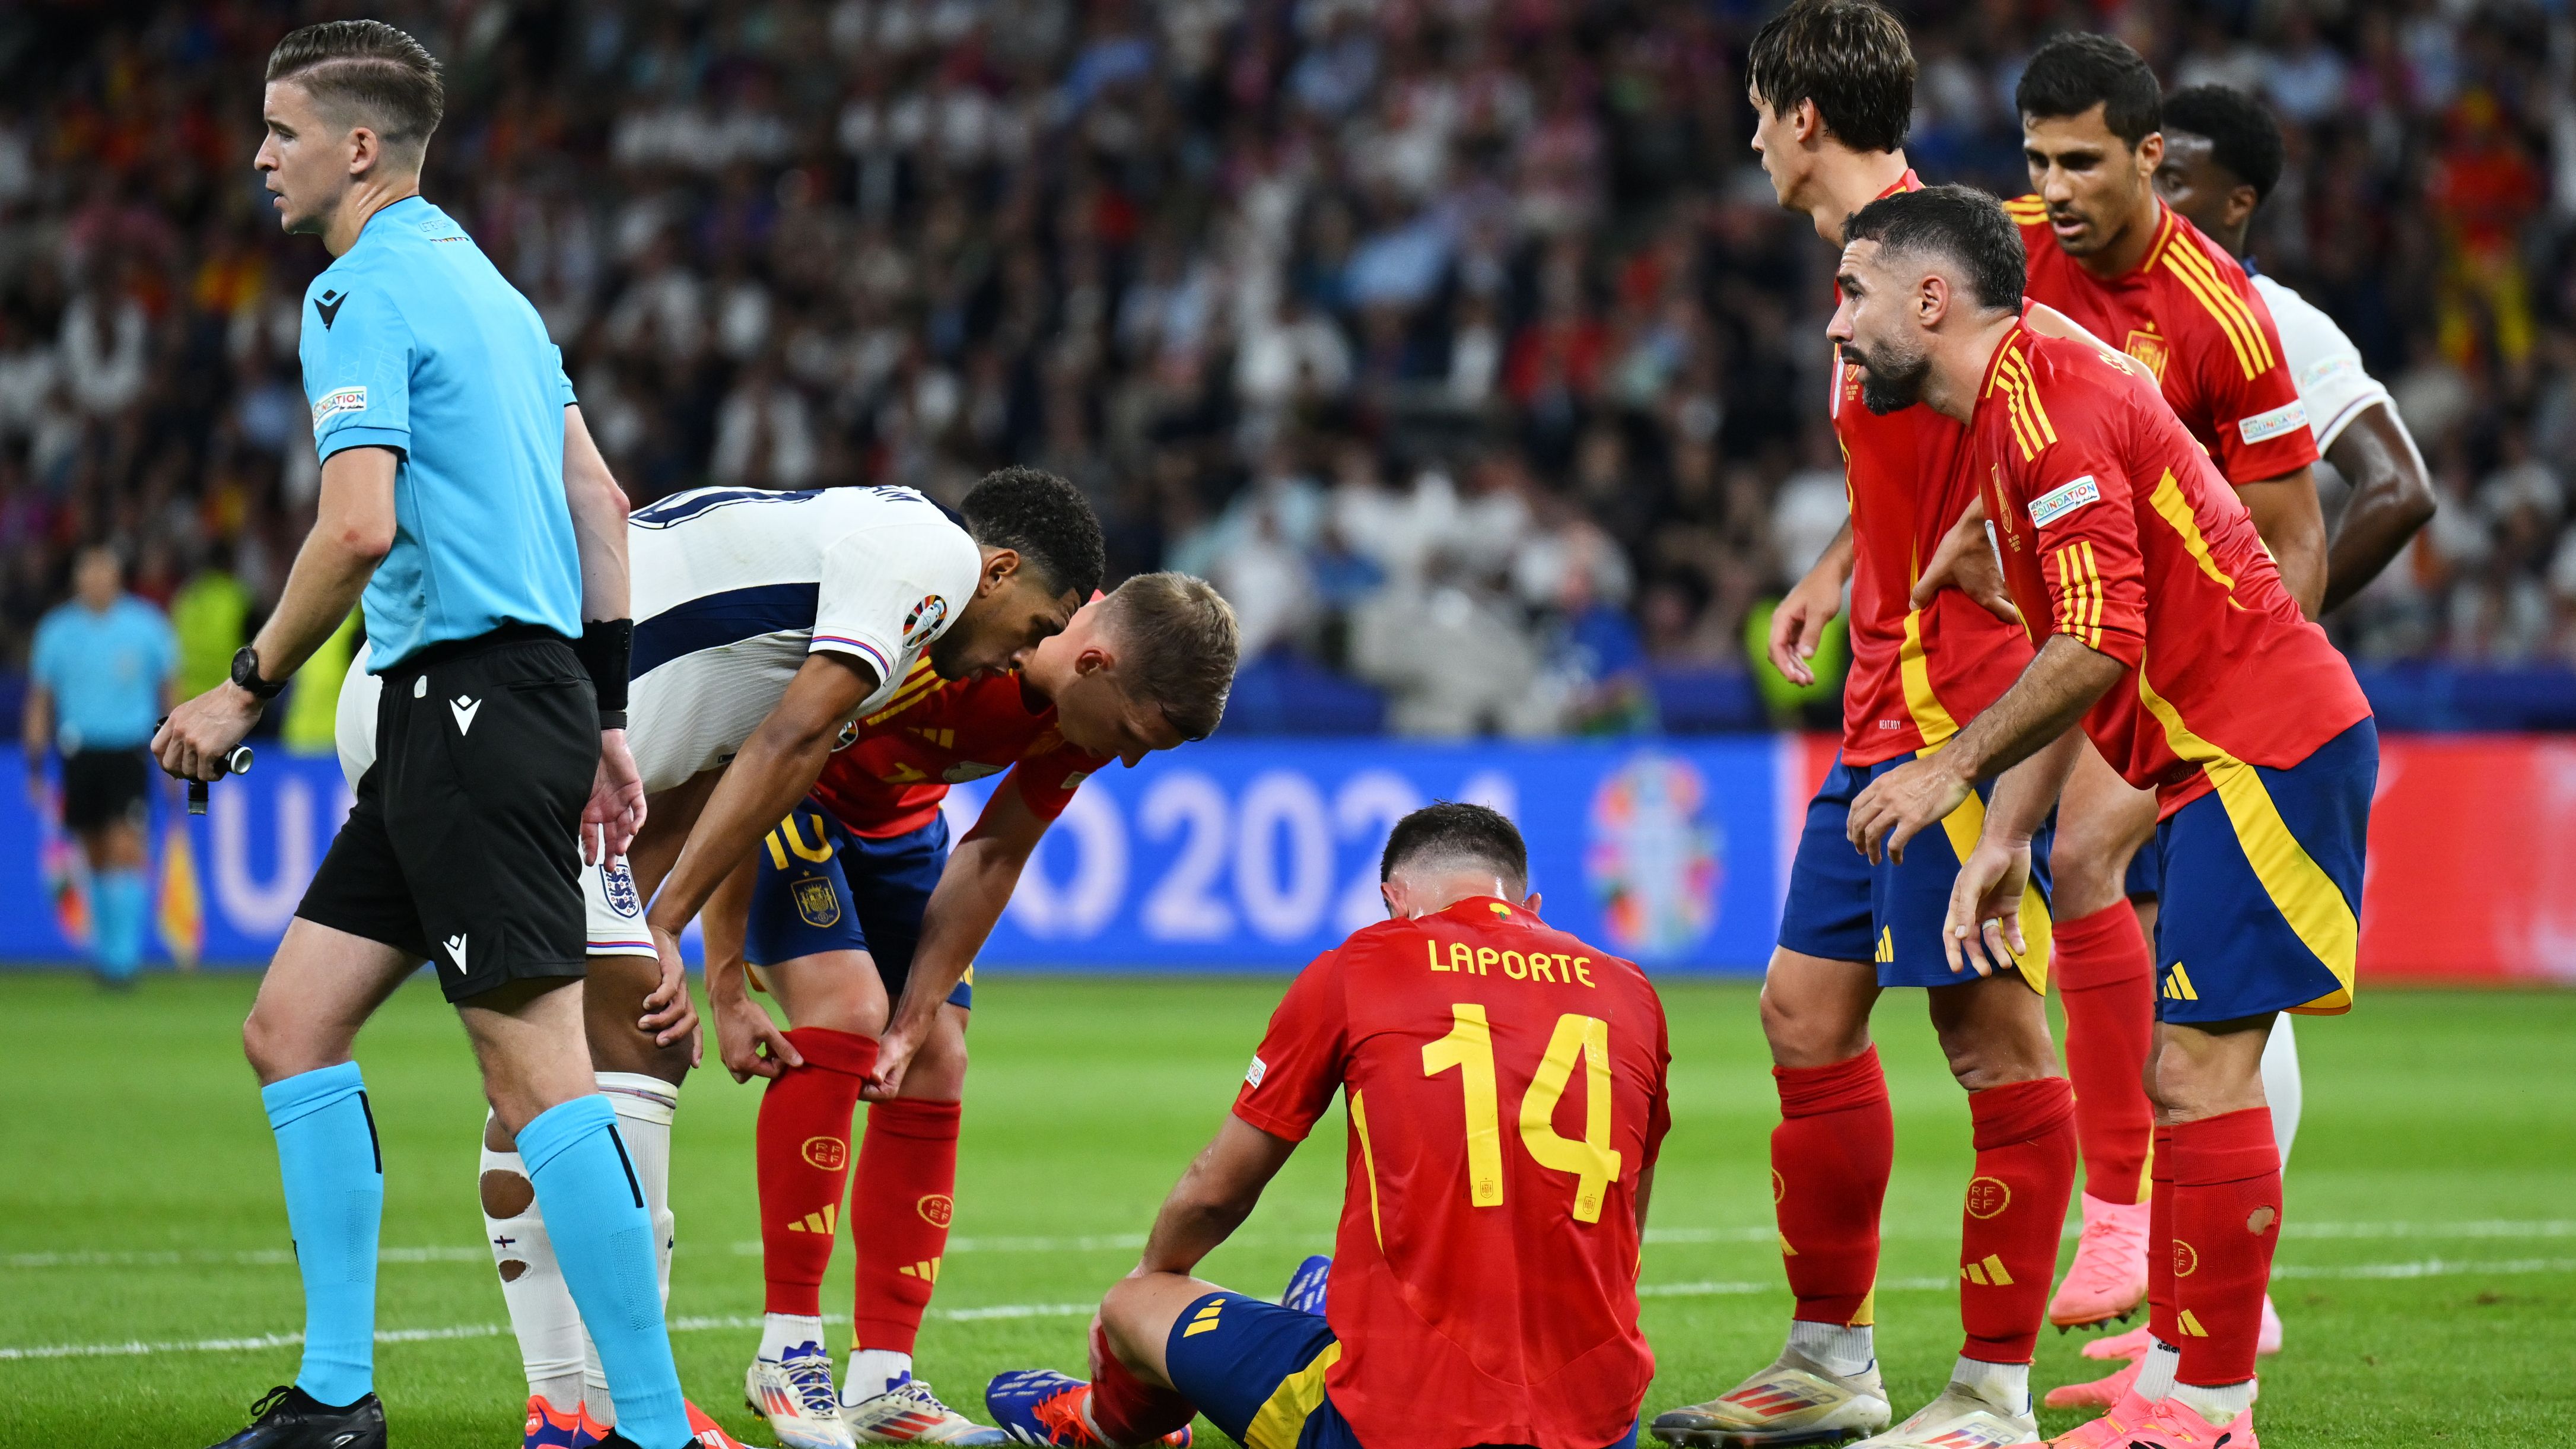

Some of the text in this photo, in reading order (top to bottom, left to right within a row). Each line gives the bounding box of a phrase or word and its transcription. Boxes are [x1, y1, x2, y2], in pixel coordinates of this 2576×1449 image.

[2033, 484, 2095, 519] FOUNDATION
[1138, 769, 1519, 943] 202
[1427, 940, 1596, 989] LAPORTE
[1421, 1003, 1621, 1224] 14
